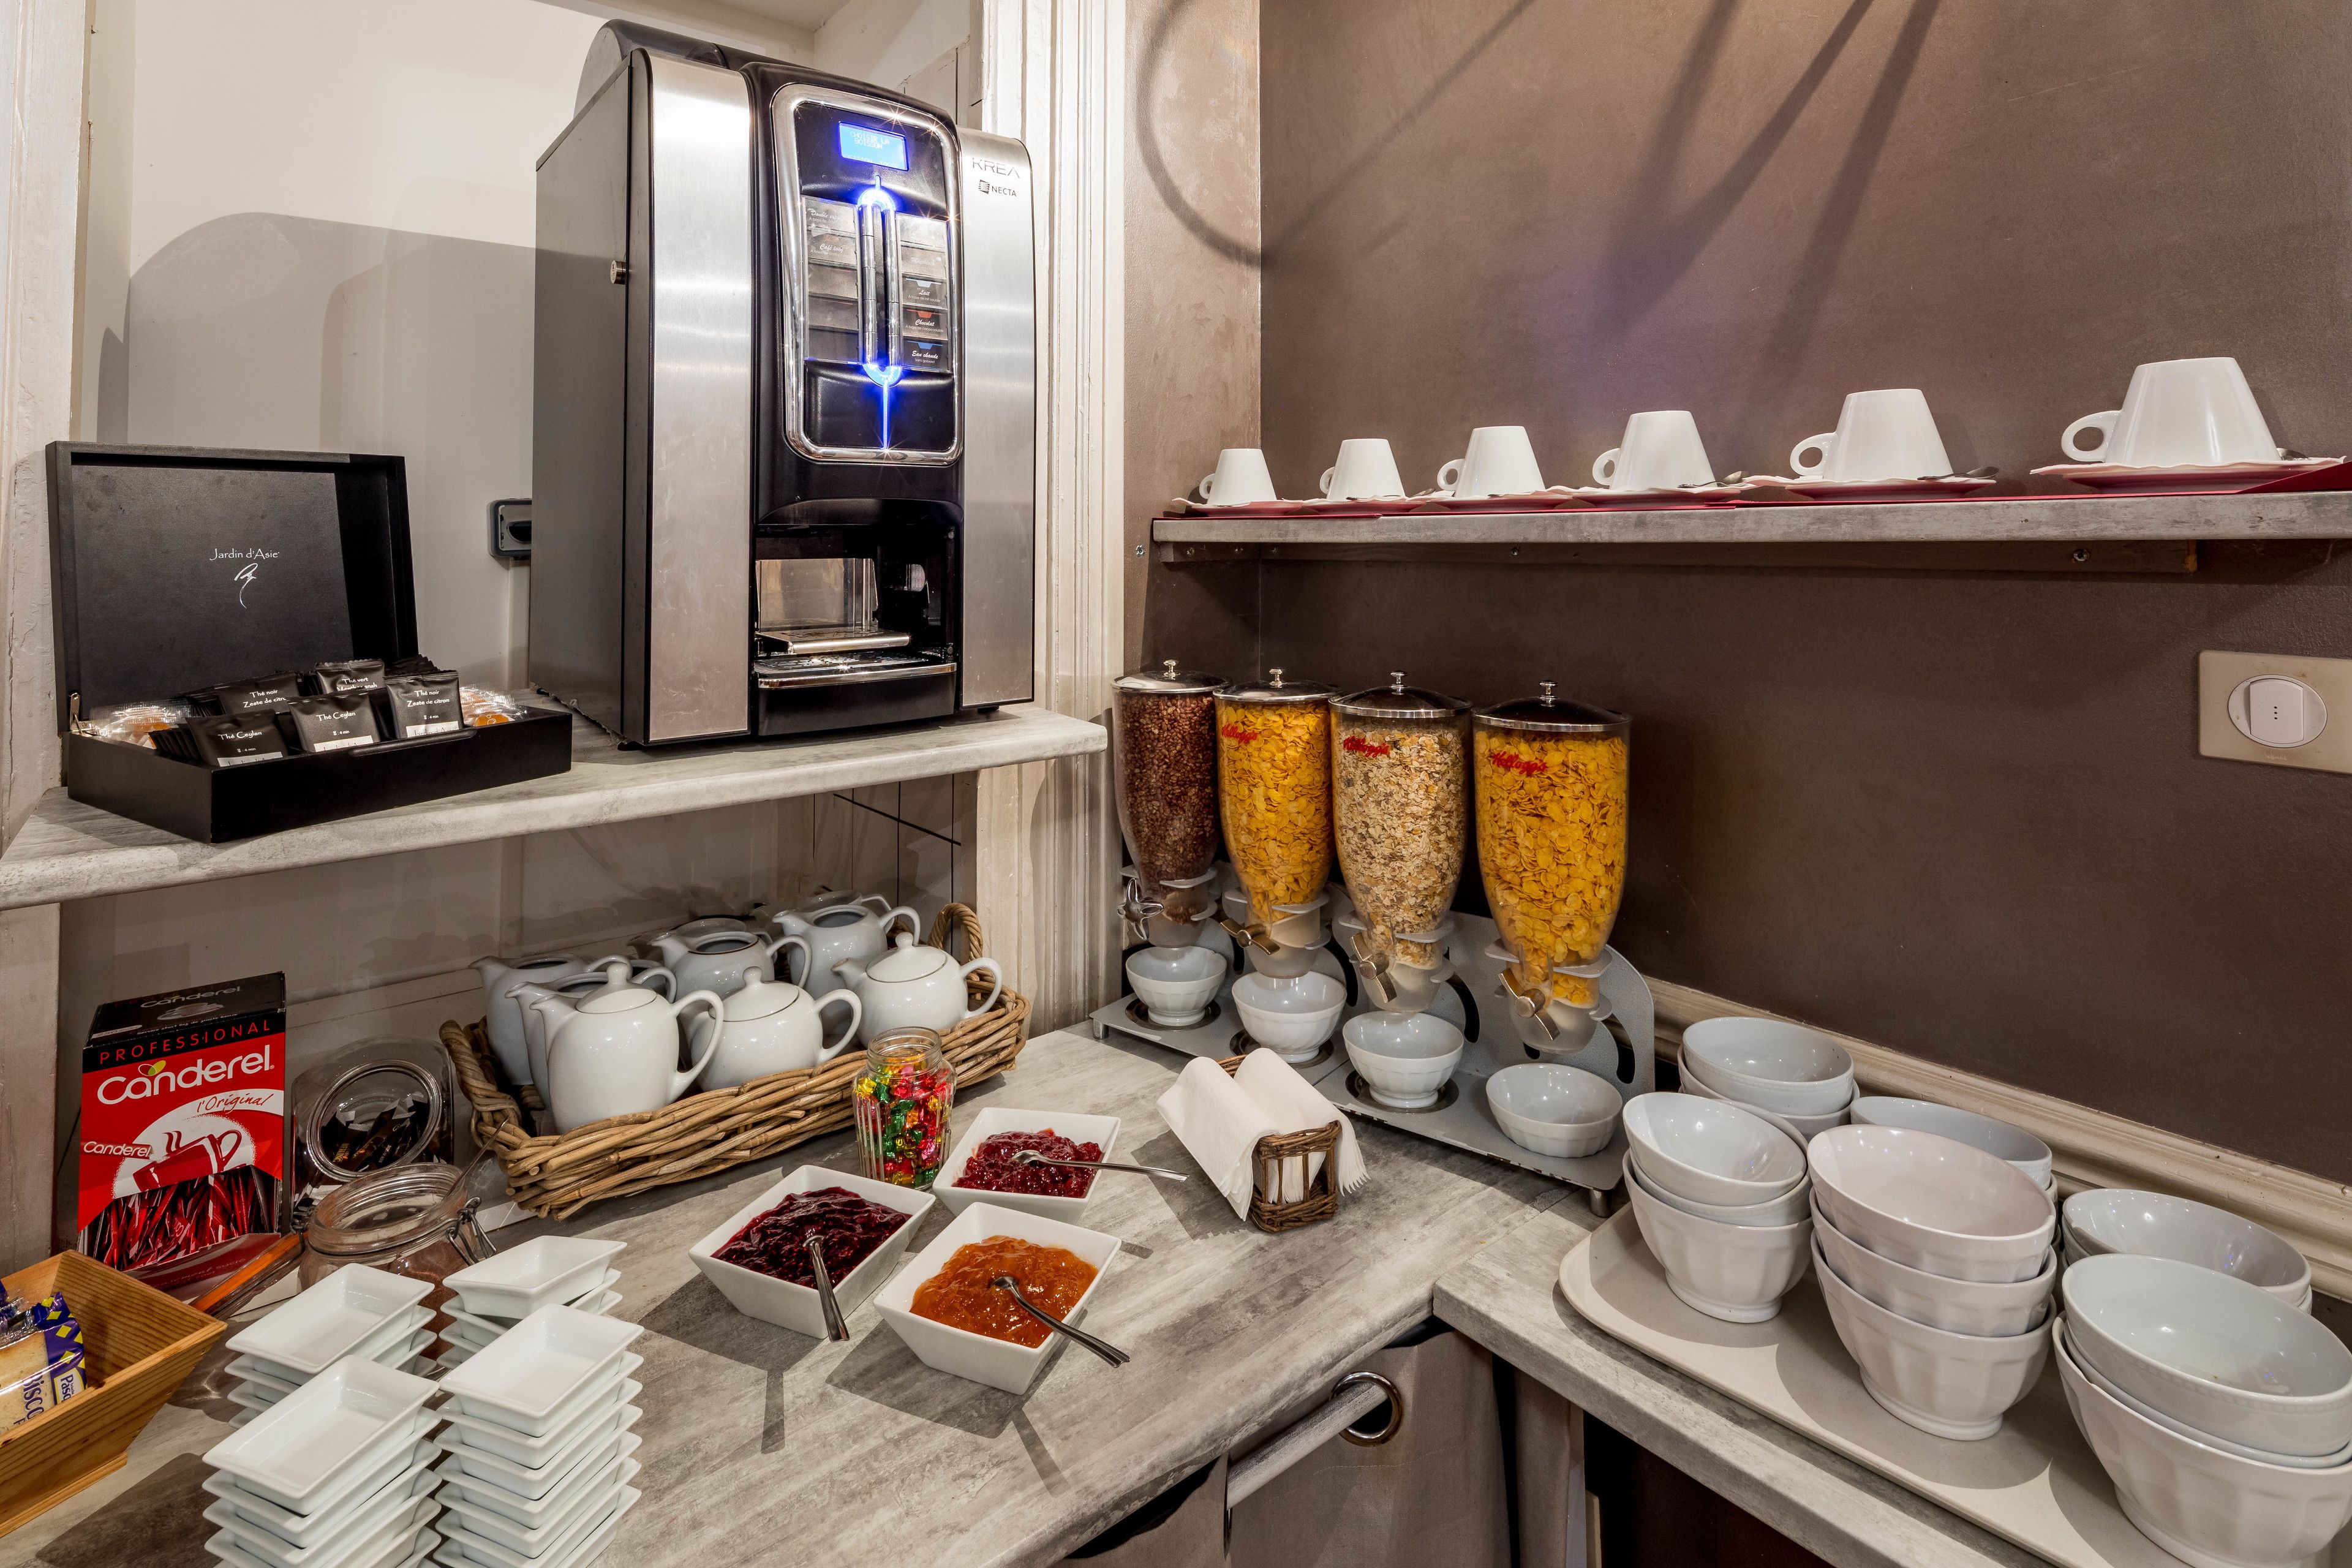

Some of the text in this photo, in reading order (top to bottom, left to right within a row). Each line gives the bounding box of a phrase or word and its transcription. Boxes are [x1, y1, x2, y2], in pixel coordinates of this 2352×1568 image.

[854, 138, 883, 149] BOISSON
[881, 136, 890, 145] LA
[992, 185, 1016, 197] NECTA
[915, 318, 935, 327] Chocolat
[209, 548, 243, 560] Jardin
[218, 730, 262, 741] Thé Ceylan
[1221, 723, 1258, 745] Kellogg's
[1343, 735, 1390, 758] Kellogg's
[1491, 750, 1547, 777] Kellogg's
[140, 986, 241, 1008] Canderel
[99, 1019, 271, 1065] PROFESSIONAL
[97, 1044, 271, 1105] Canderel
[197, 1093, 274, 1115] l'Original
[83, 1140, 151, 1158] Canderel
